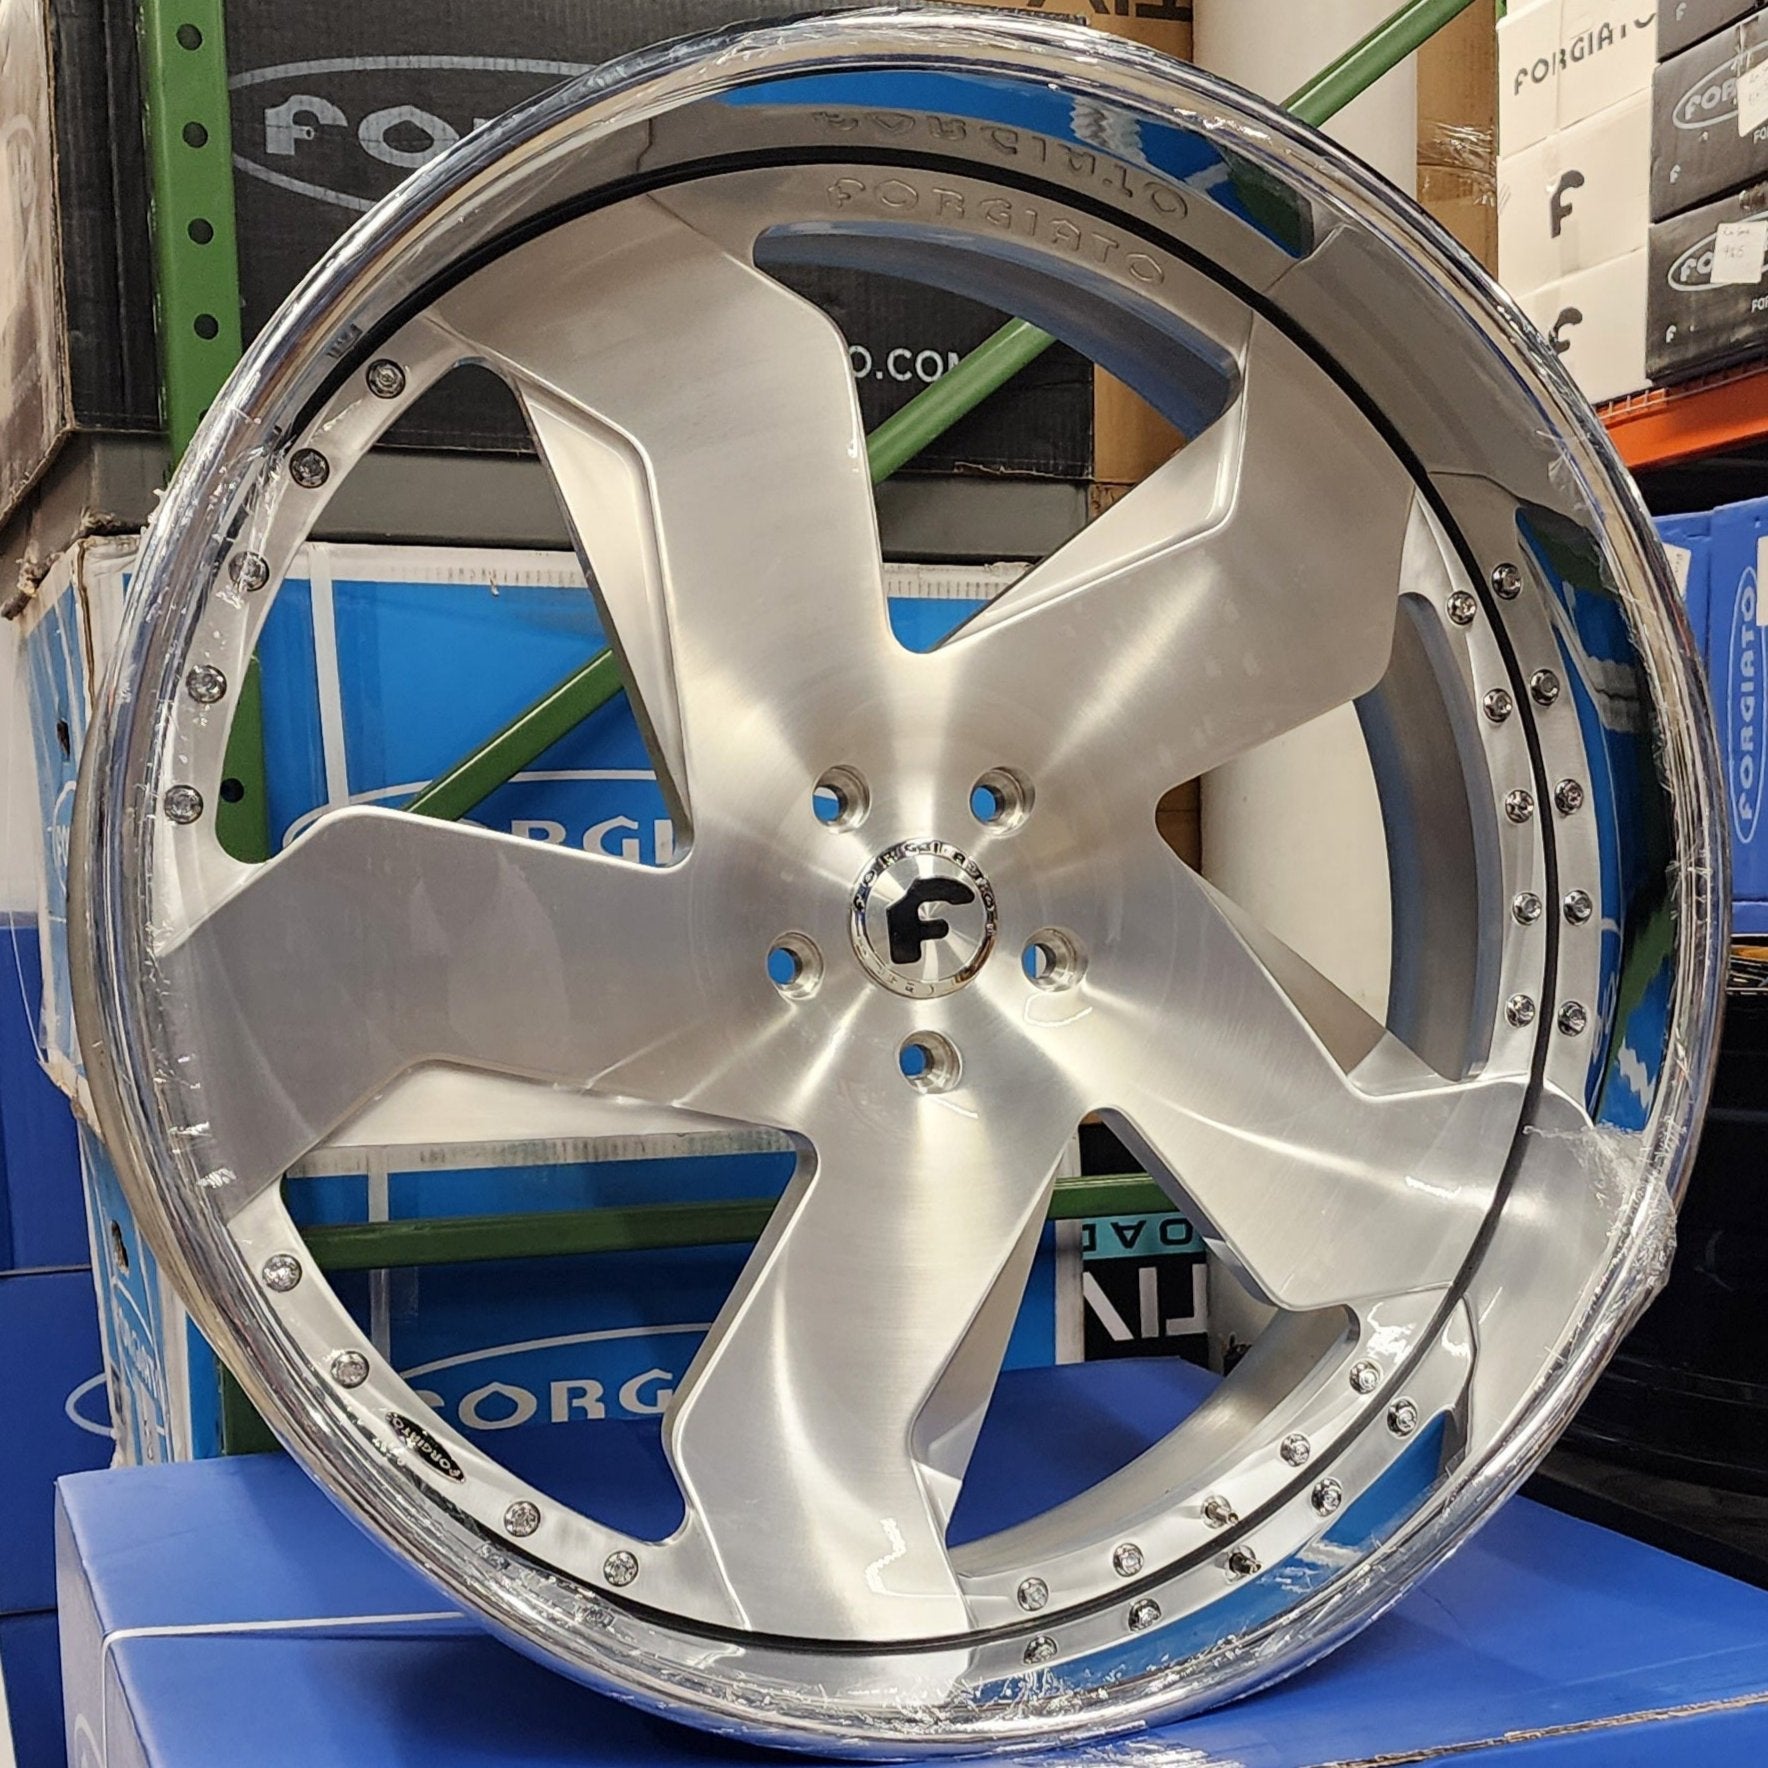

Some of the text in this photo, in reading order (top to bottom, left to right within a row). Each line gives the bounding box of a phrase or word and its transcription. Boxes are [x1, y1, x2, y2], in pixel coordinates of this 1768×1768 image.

[264, 94, 490, 168] FO
[826, 176, 1166, 285] FORGIATO
[1738, 586, 1755, 820] FORGIATO
[886, 877, 975, 965] F
[391, 1416, 461, 1478] FORGIATO
